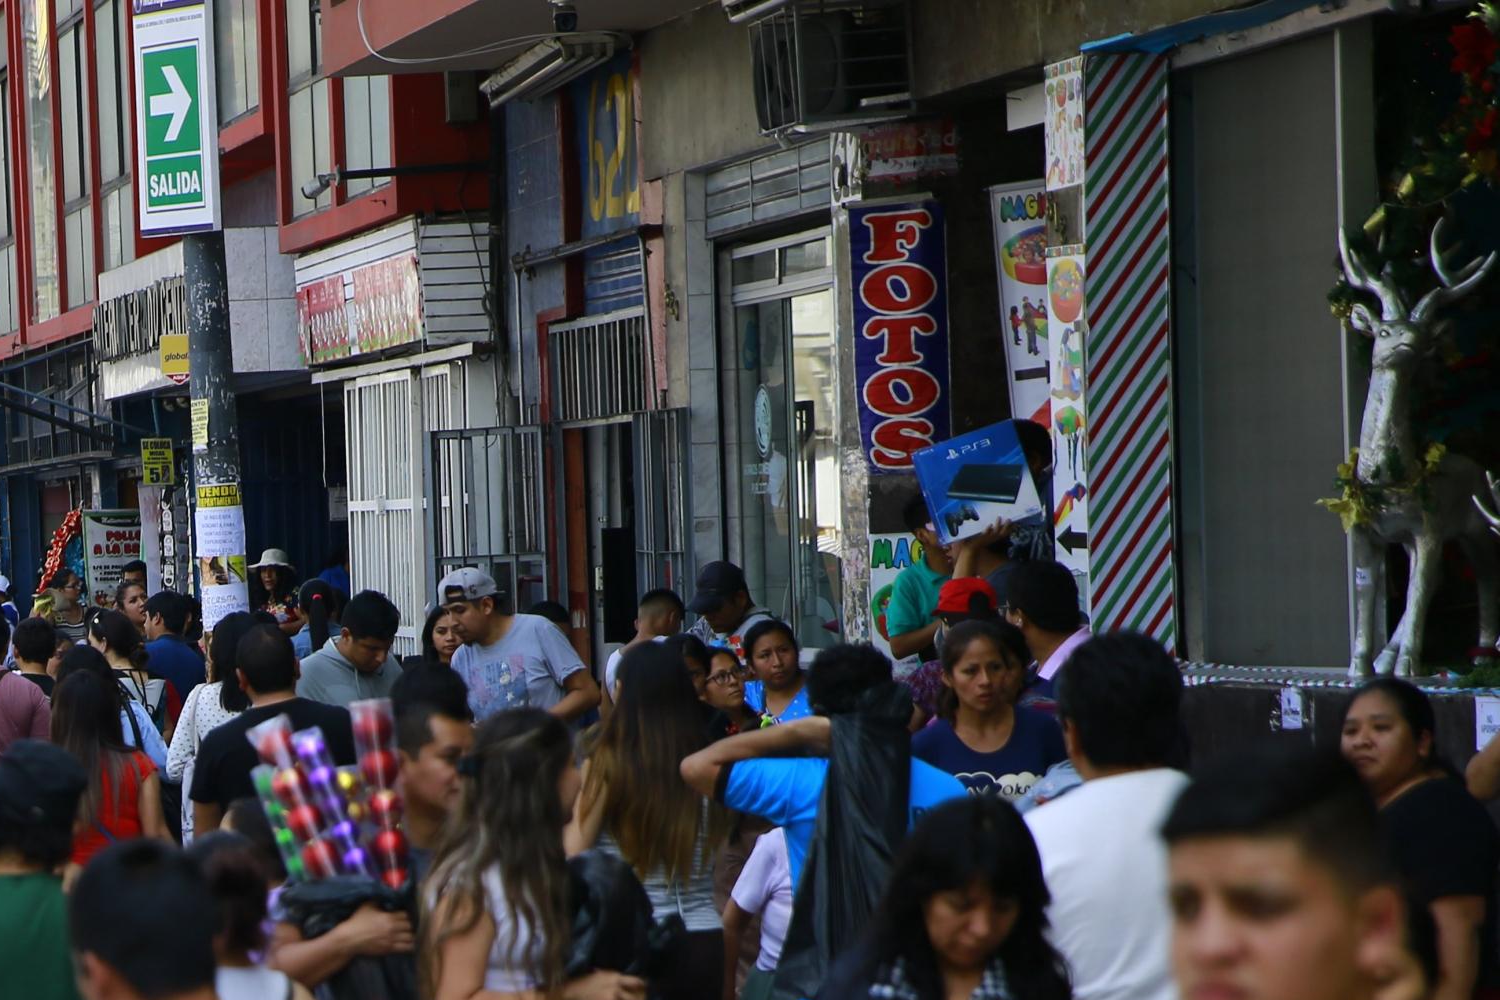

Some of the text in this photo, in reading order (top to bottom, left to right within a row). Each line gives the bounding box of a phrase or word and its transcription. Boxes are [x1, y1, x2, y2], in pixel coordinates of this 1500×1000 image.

[150, 170, 200, 197] SALIDA
[860, 209, 941, 470] FOTOS
[961, 438, 991, 455] PS3
[199, 486, 237, 498] VENDO
[93, 543, 103, 556] A
[105, 543, 122, 556] LA
